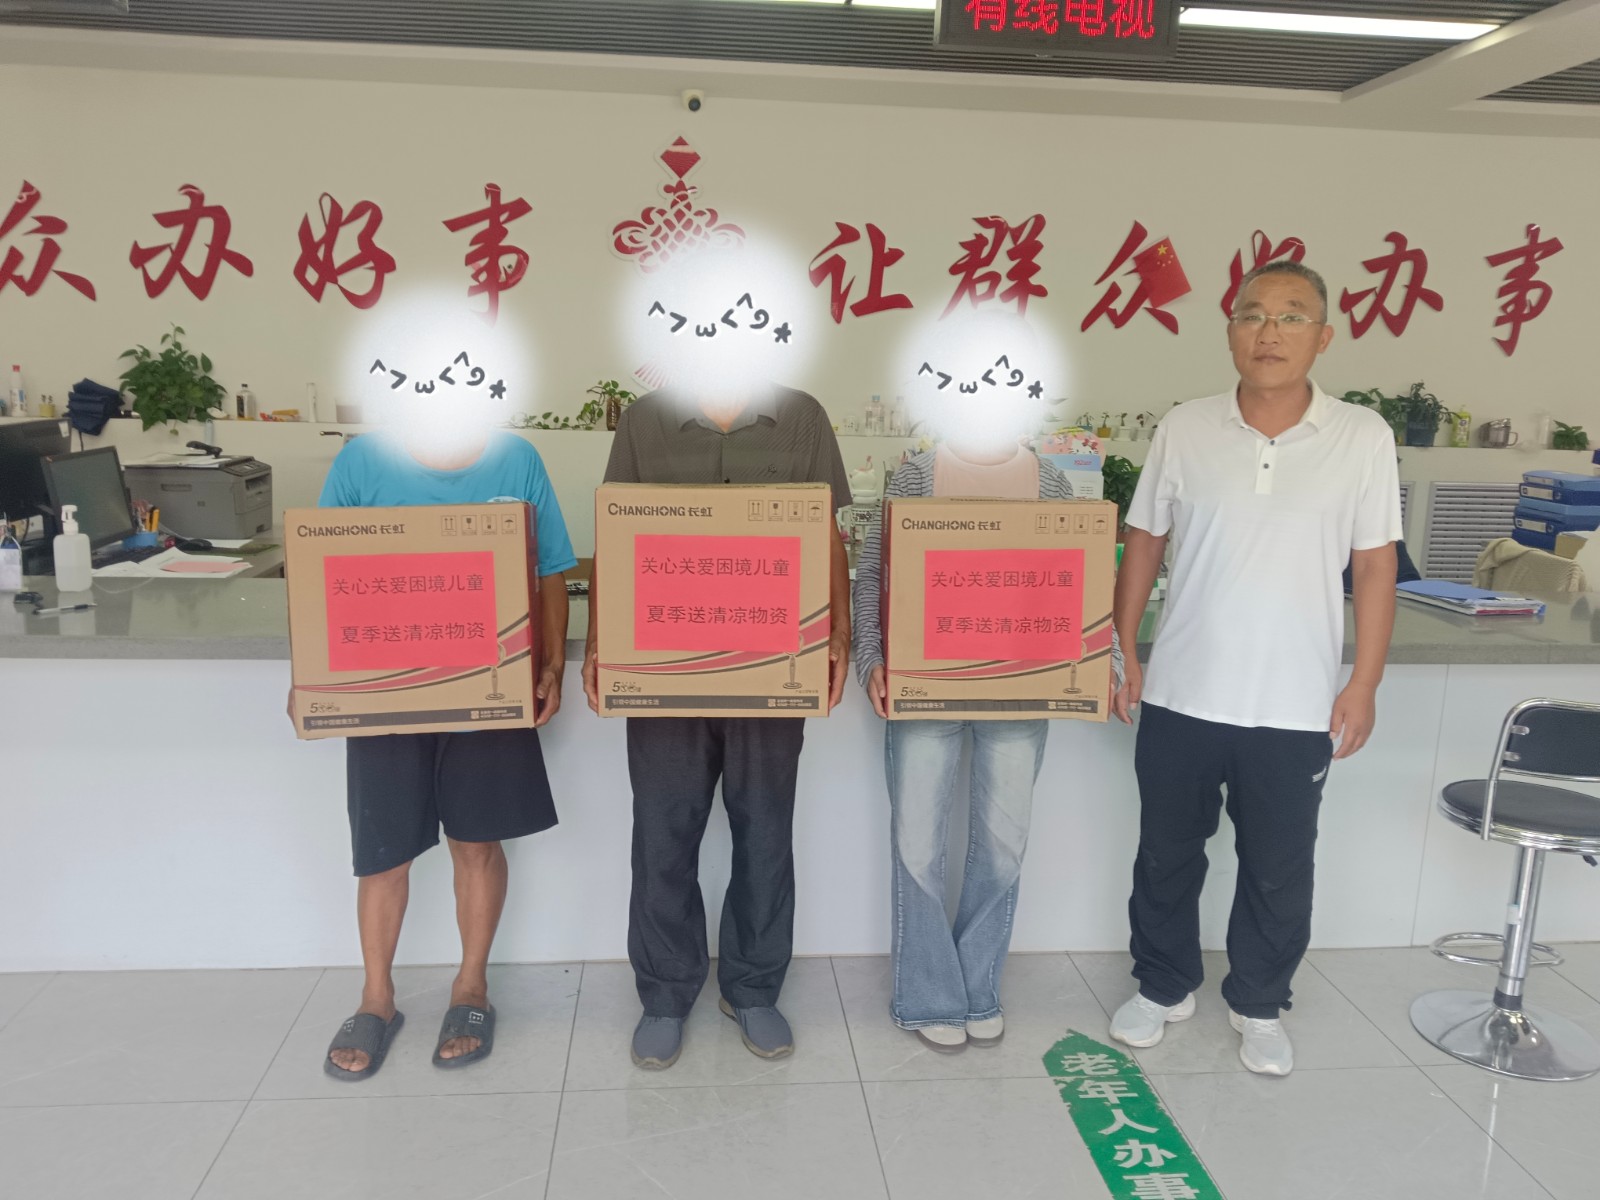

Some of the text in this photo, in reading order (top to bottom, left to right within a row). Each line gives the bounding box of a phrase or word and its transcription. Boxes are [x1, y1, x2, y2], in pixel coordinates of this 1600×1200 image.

[964, 0, 1156, 39] 有线电视
[0, 179, 534, 328] 众办好事
[608, 502, 713, 518] CHANGHONG 长虹
[297, 523, 405, 538] CHANGHONG 长虹
[901, 517, 1002, 531] CHANGHONG 长虹
[641, 557, 790, 577] 关心关爱困境儿童
[332, 573, 484, 596] 关心关爱困境儿童
[931, 570, 1074, 588] 关心关爱困境儿童
[646, 604, 788, 625] 夏季送清凉物资
[340, 621, 486, 645] 夏季送清凉物资
[935, 616, 1071, 634] 夏季送清凉物资
[1060, 1052, 1200, 1200] 老年人办事
